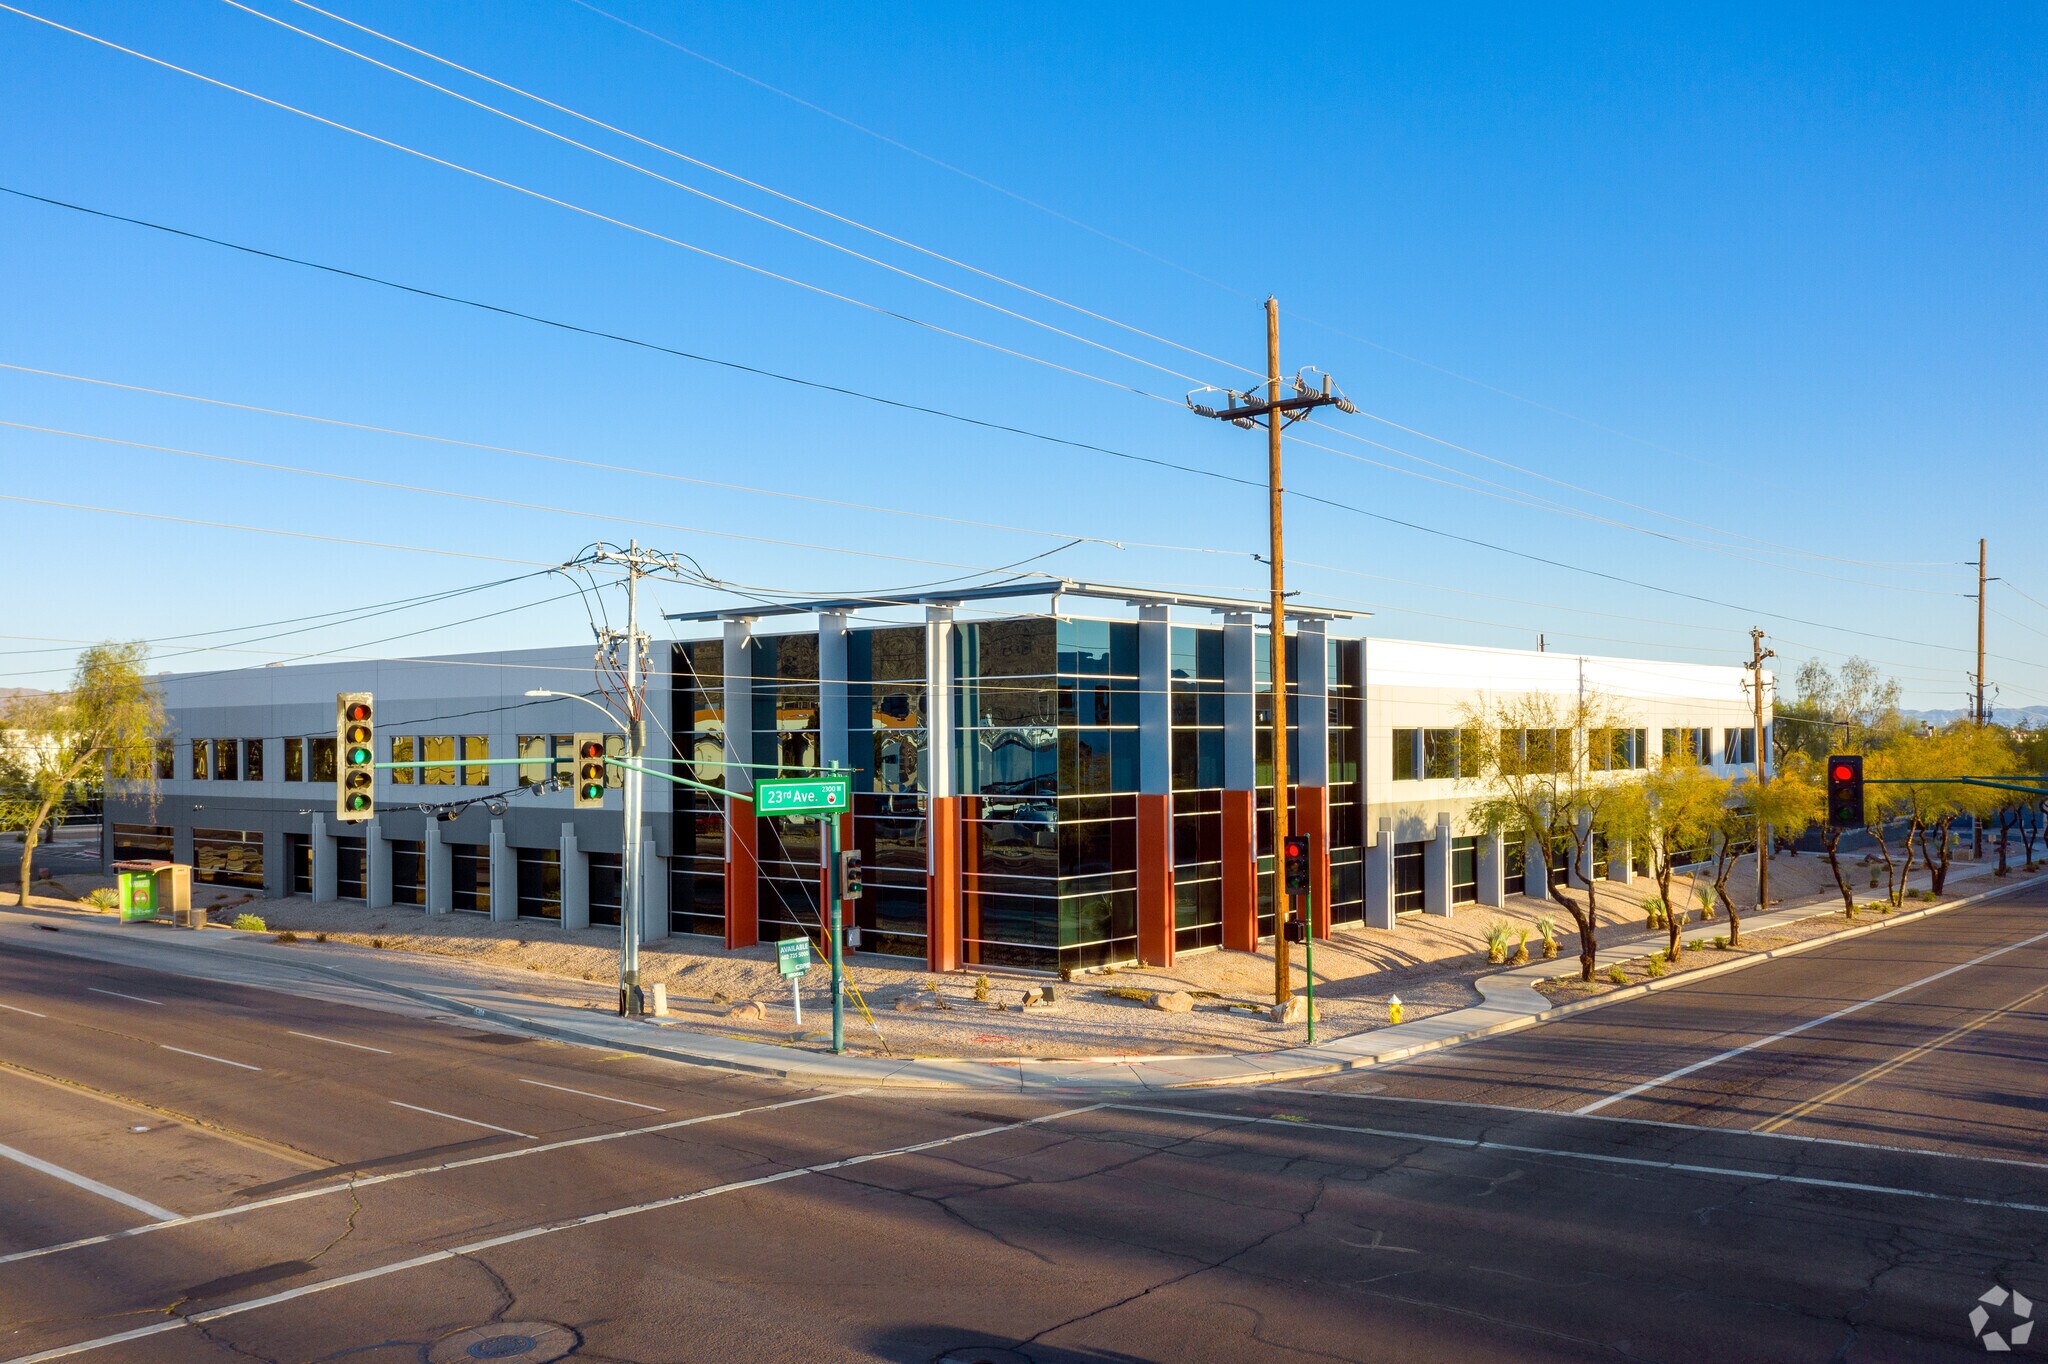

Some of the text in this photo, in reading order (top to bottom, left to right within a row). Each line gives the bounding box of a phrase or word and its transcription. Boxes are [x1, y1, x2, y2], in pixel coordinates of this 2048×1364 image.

[768, 790, 818, 804] 23rd Ave.
[780, 943, 808, 953] AVAILABLE
